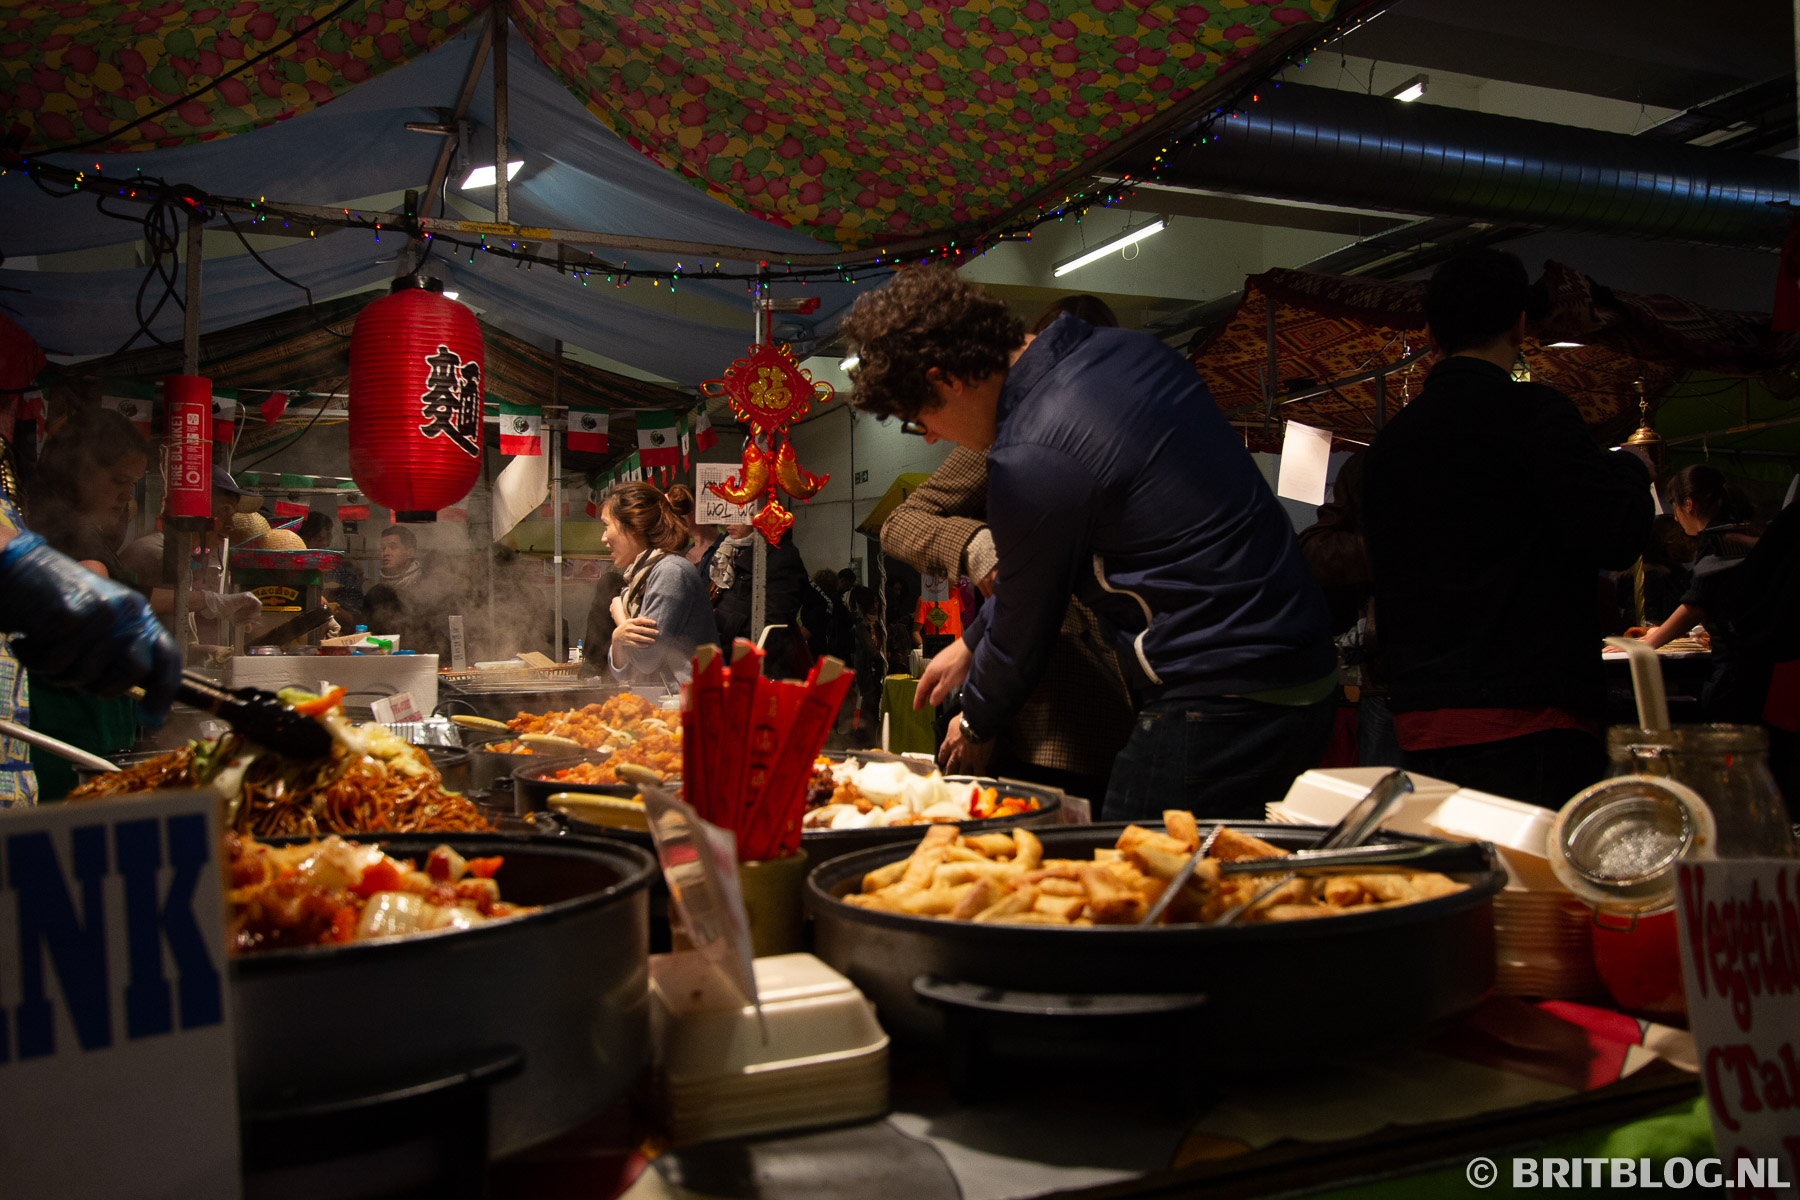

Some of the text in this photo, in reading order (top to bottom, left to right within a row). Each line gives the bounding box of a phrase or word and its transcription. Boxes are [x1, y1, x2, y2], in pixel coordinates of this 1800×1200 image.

[171, 415, 183, 487] FIRE BLANKET
[0, 814, 222, 1064] NK
[1679, 865, 1800, 1033] Vegetab
